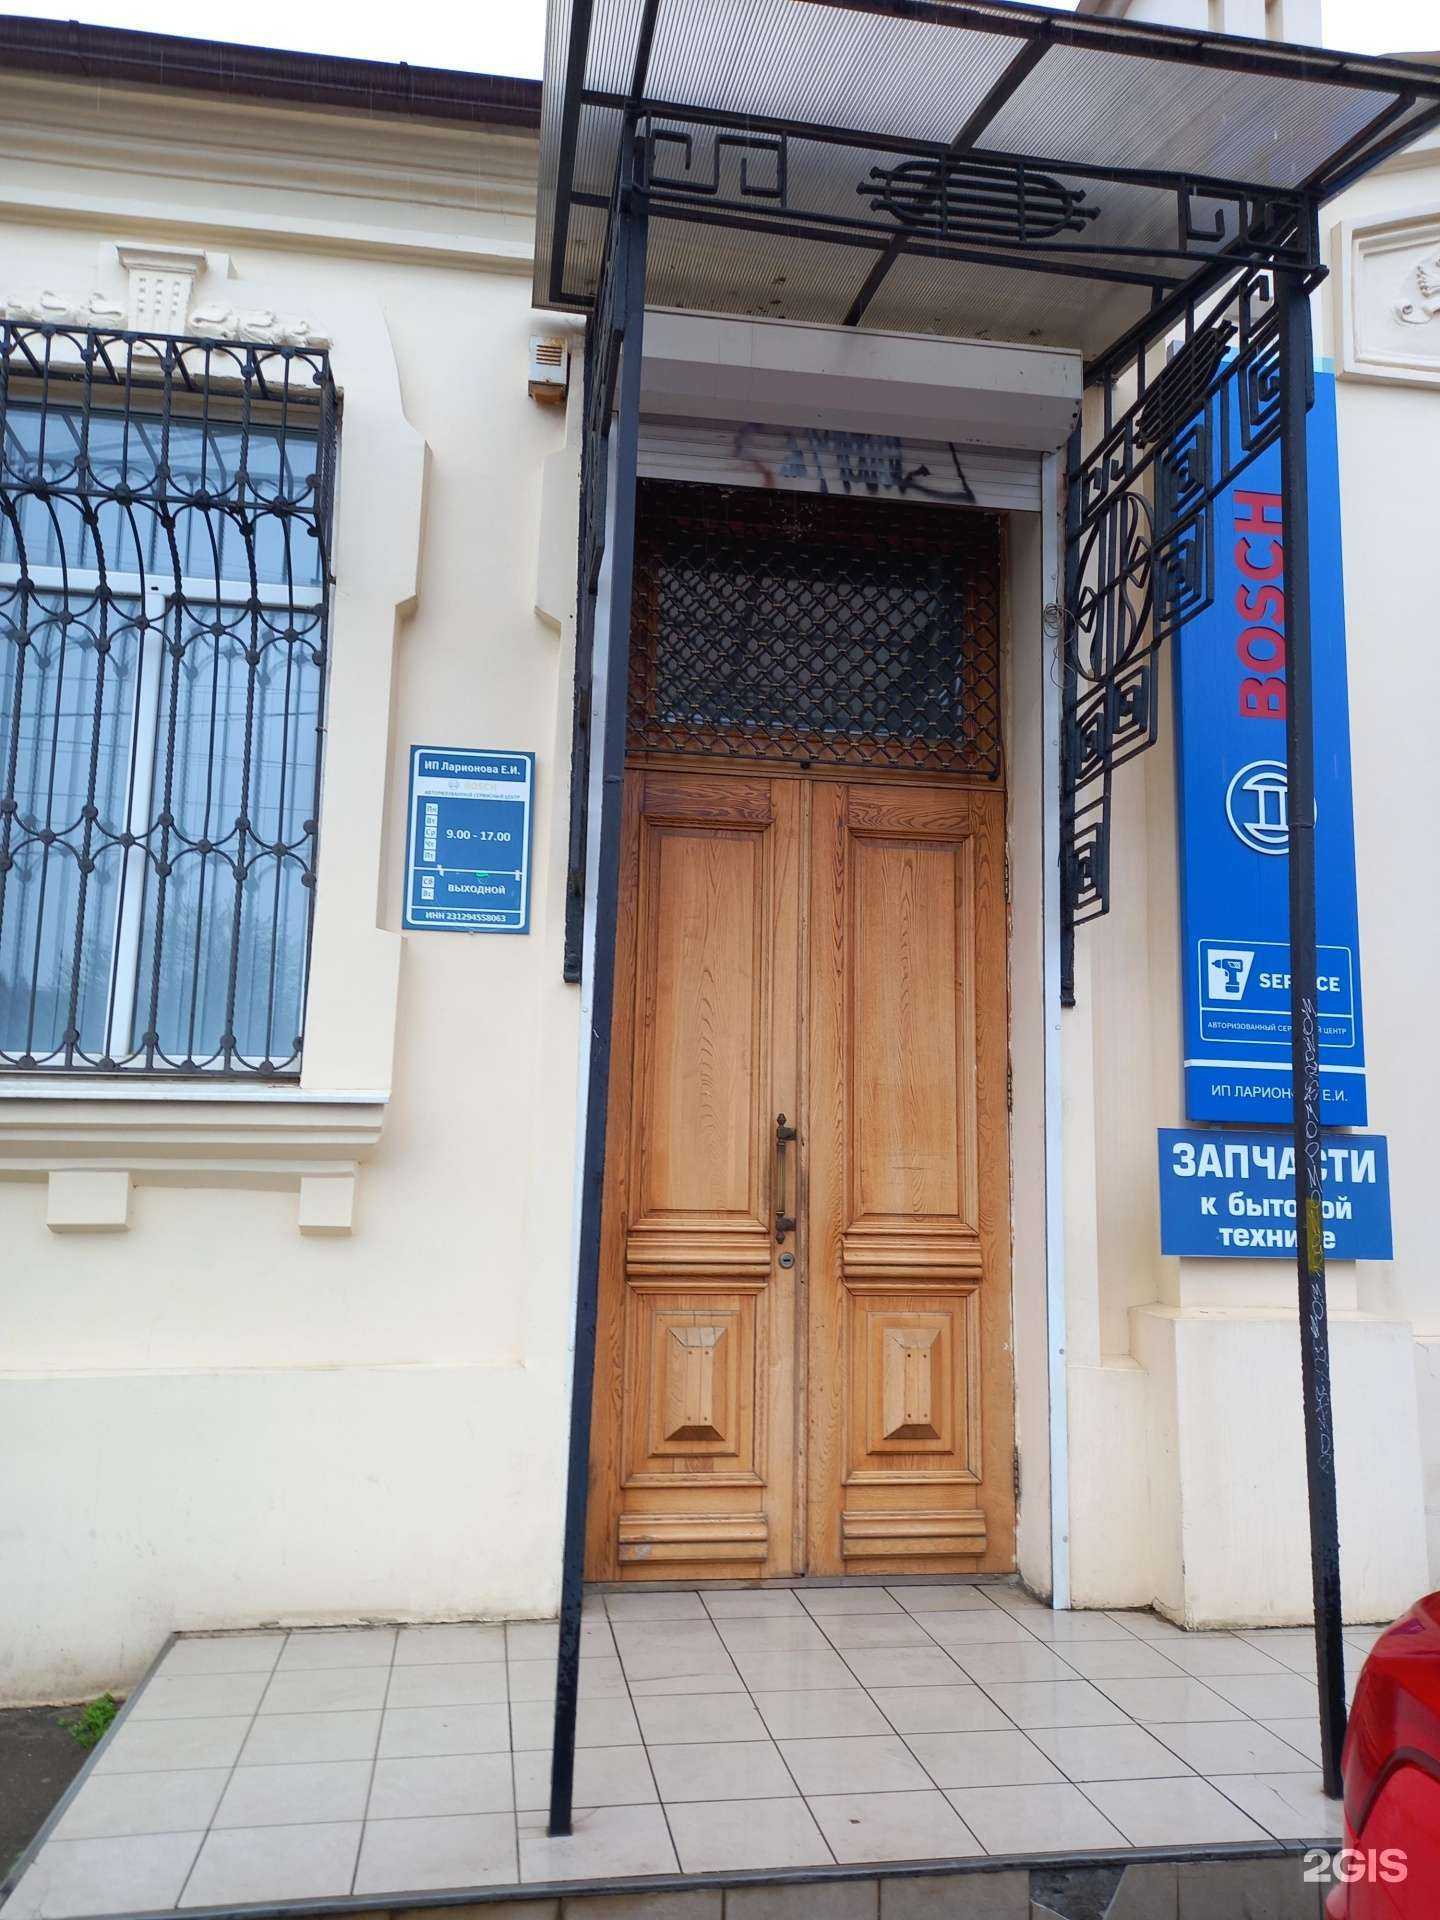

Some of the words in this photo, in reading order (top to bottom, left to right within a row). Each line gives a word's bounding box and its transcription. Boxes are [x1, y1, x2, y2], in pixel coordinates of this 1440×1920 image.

[1233, 490, 1288, 720] BOSCH
[424, 760, 440, 770] ИП
[441, 761, 499, 775] Ларионова
[501, 764, 520, 775] Е.И.
[446, 829, 470, 840] 9.00
[480, 831, 511, 842] 17.00
[425, 911, 445, 920] ИНН
[1207, 1021, 1276, 1031] АВТОРИЗОВАННЫЙ
[1323, 1027, 1347, 1035] ЦЕНТР
[1211, 1084, 1231, 1097] ИП
[1234, 1086, 1294, 1099] ЛАРИОН
[1322, 1089, 1349, 1101] Е.И.
[1201, 1196, 1218, 1216] к
[1229, 1191, 1353, 1220] бытоой
[1219, 1227, 1336, 1249] техние
